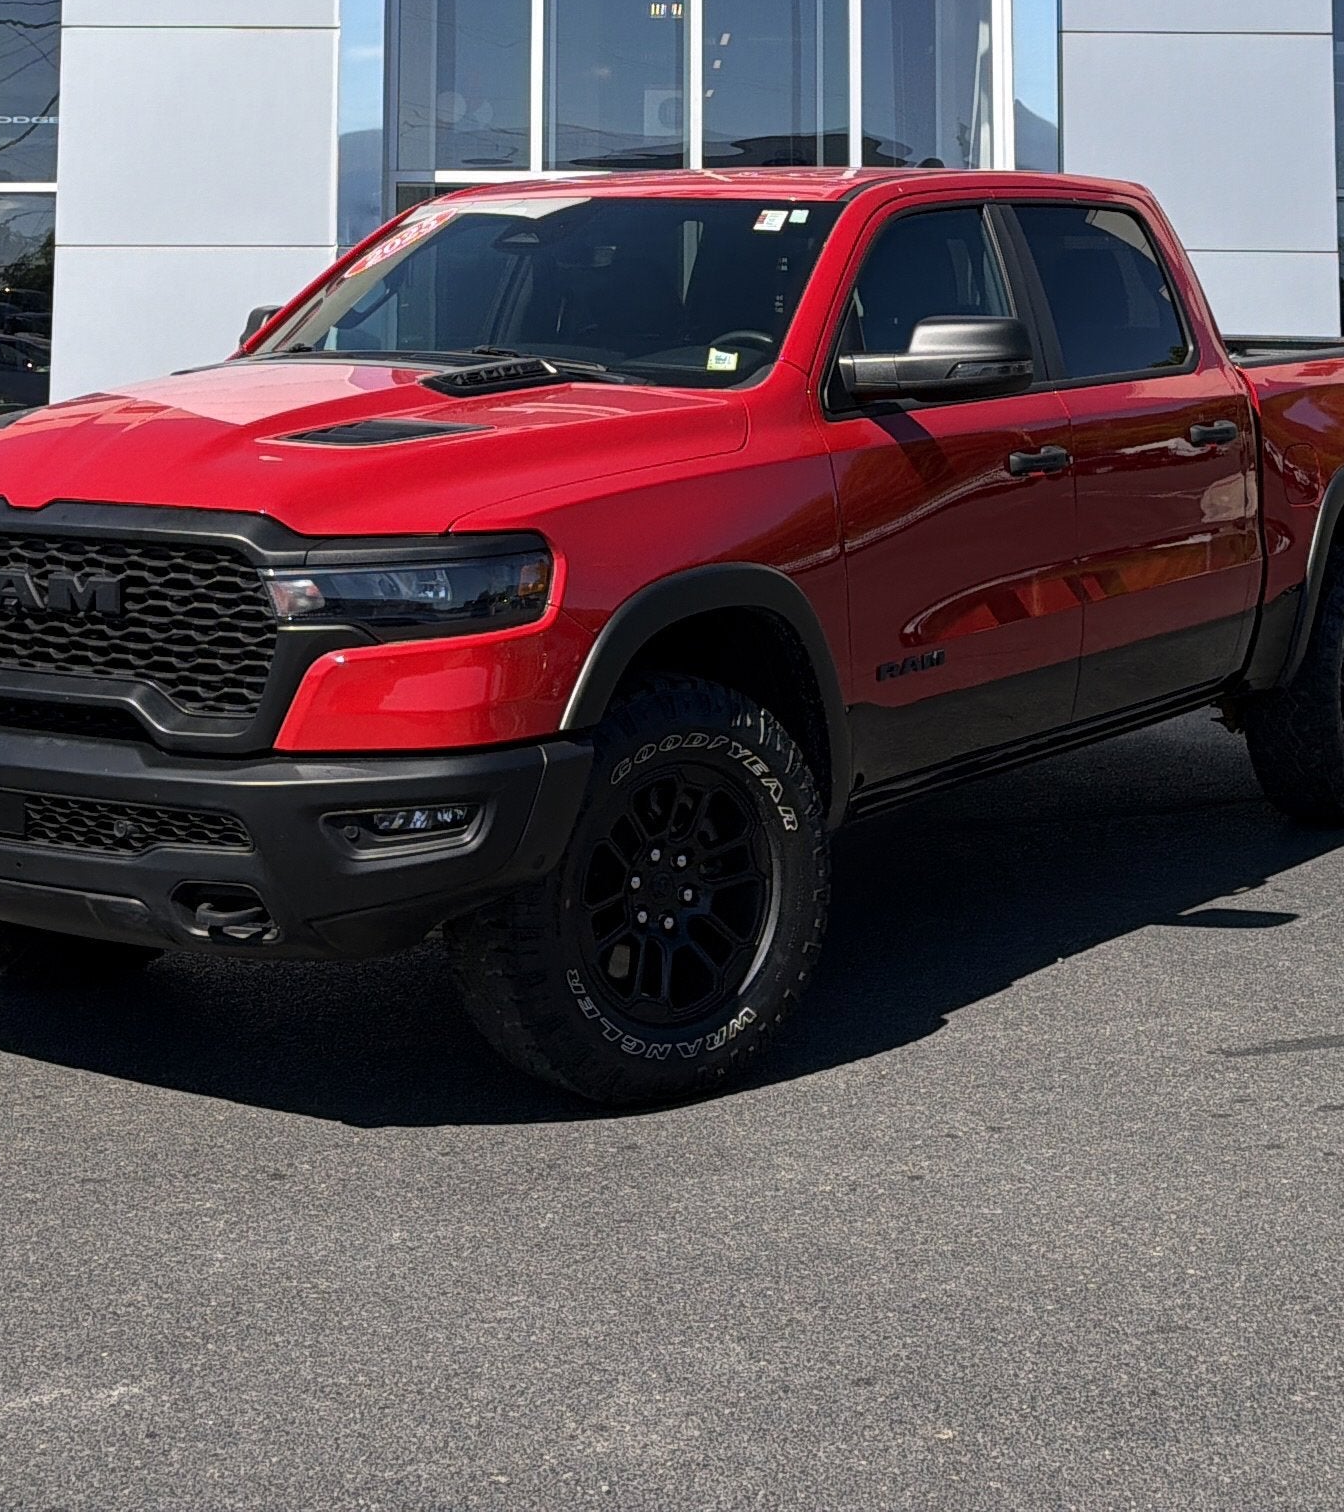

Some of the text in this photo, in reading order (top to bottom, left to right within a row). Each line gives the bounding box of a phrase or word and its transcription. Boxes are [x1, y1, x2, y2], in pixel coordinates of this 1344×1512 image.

[876, 649, 945, 682] RAM
[610, 732, 801, 833] GOODYEAR
[564, 967, 759, 1061] WRANGLER
